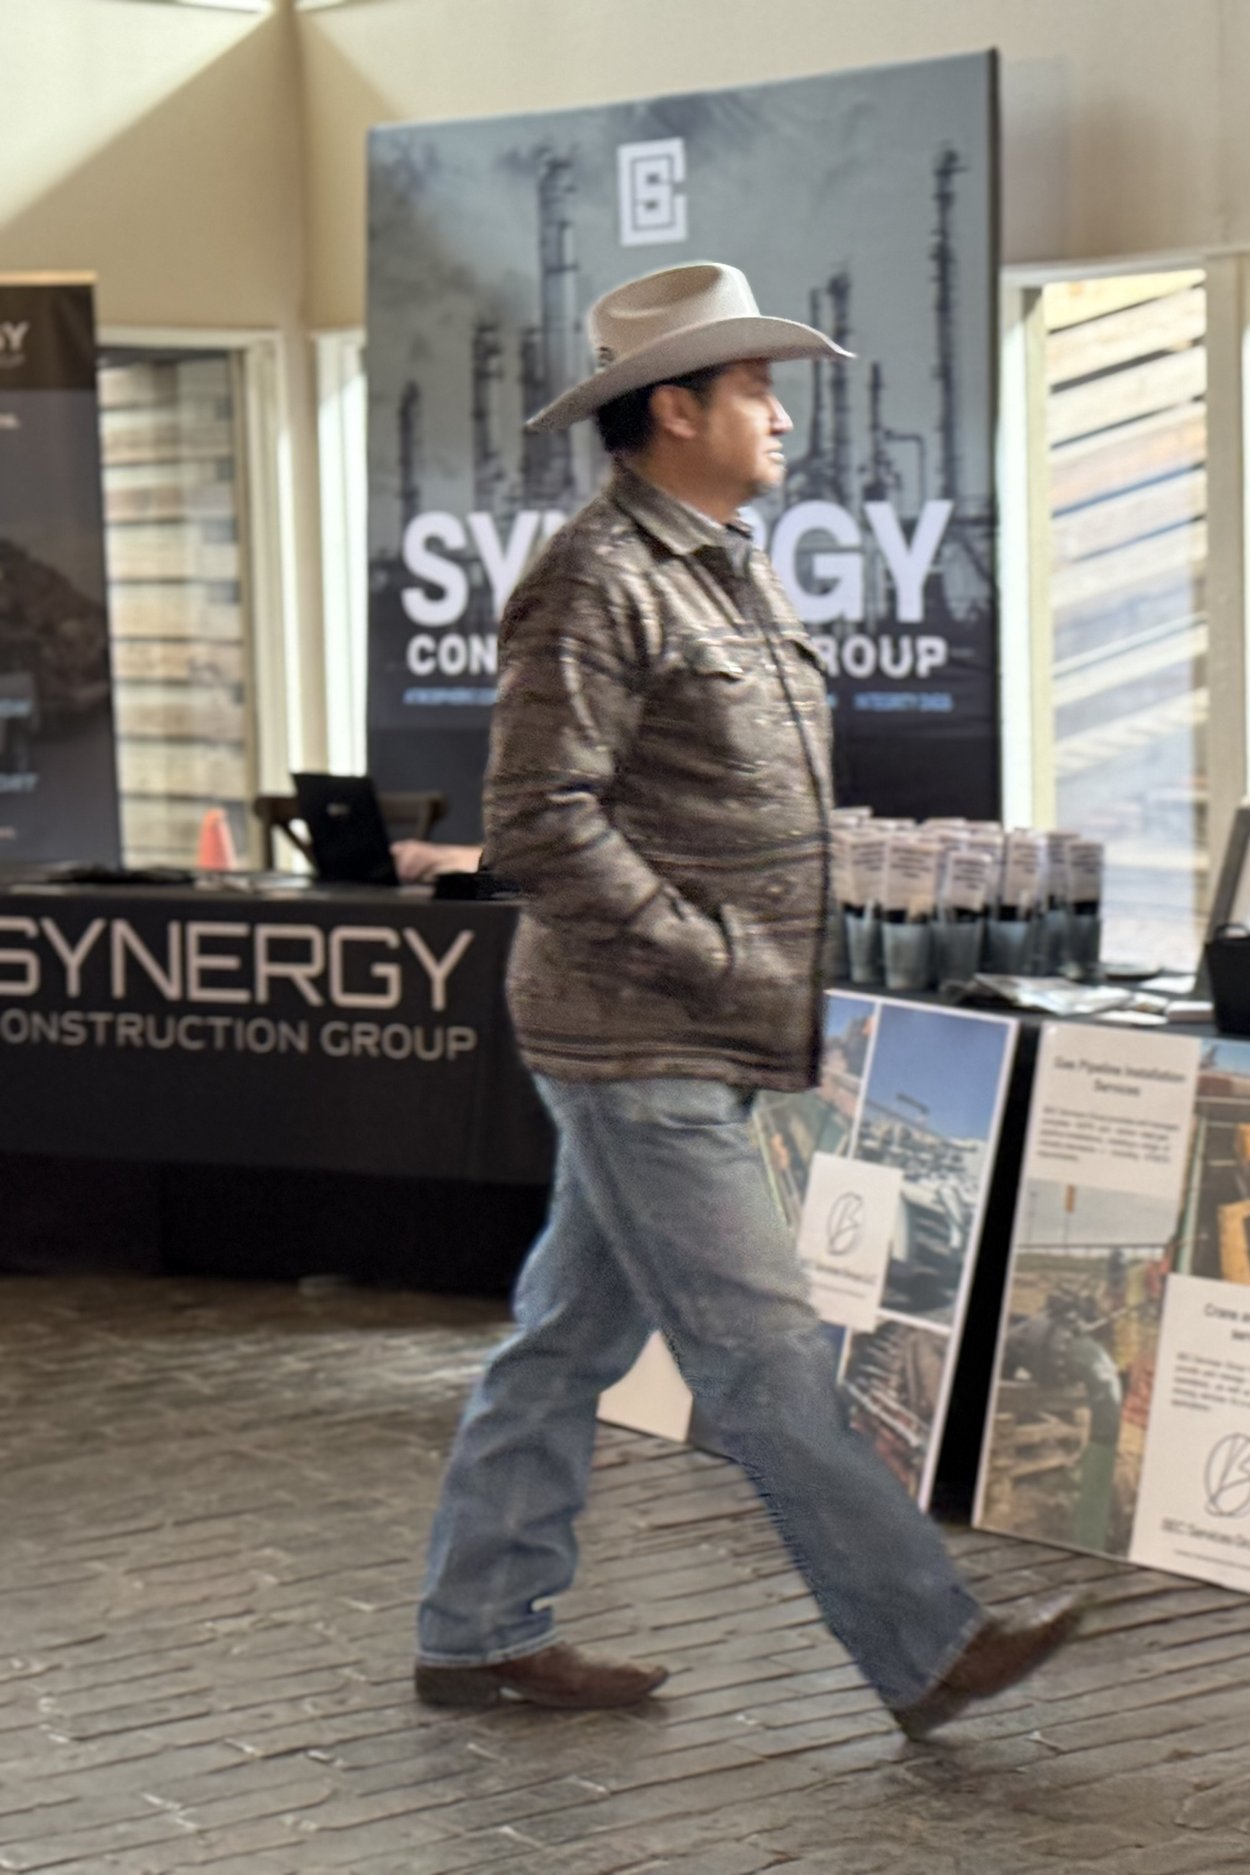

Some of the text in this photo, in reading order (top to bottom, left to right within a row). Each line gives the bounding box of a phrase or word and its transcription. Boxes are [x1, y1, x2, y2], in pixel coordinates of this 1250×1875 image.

[402, 500, 954, 627] SYGY
[812, 633, 948, 678] ROUP
[0, 915, 475, 1012] SYNERGY
[0, 1008, 478, 1061] ONSTRUCTION GROUP
[1203, 1302, 1239, 1321] Crane
